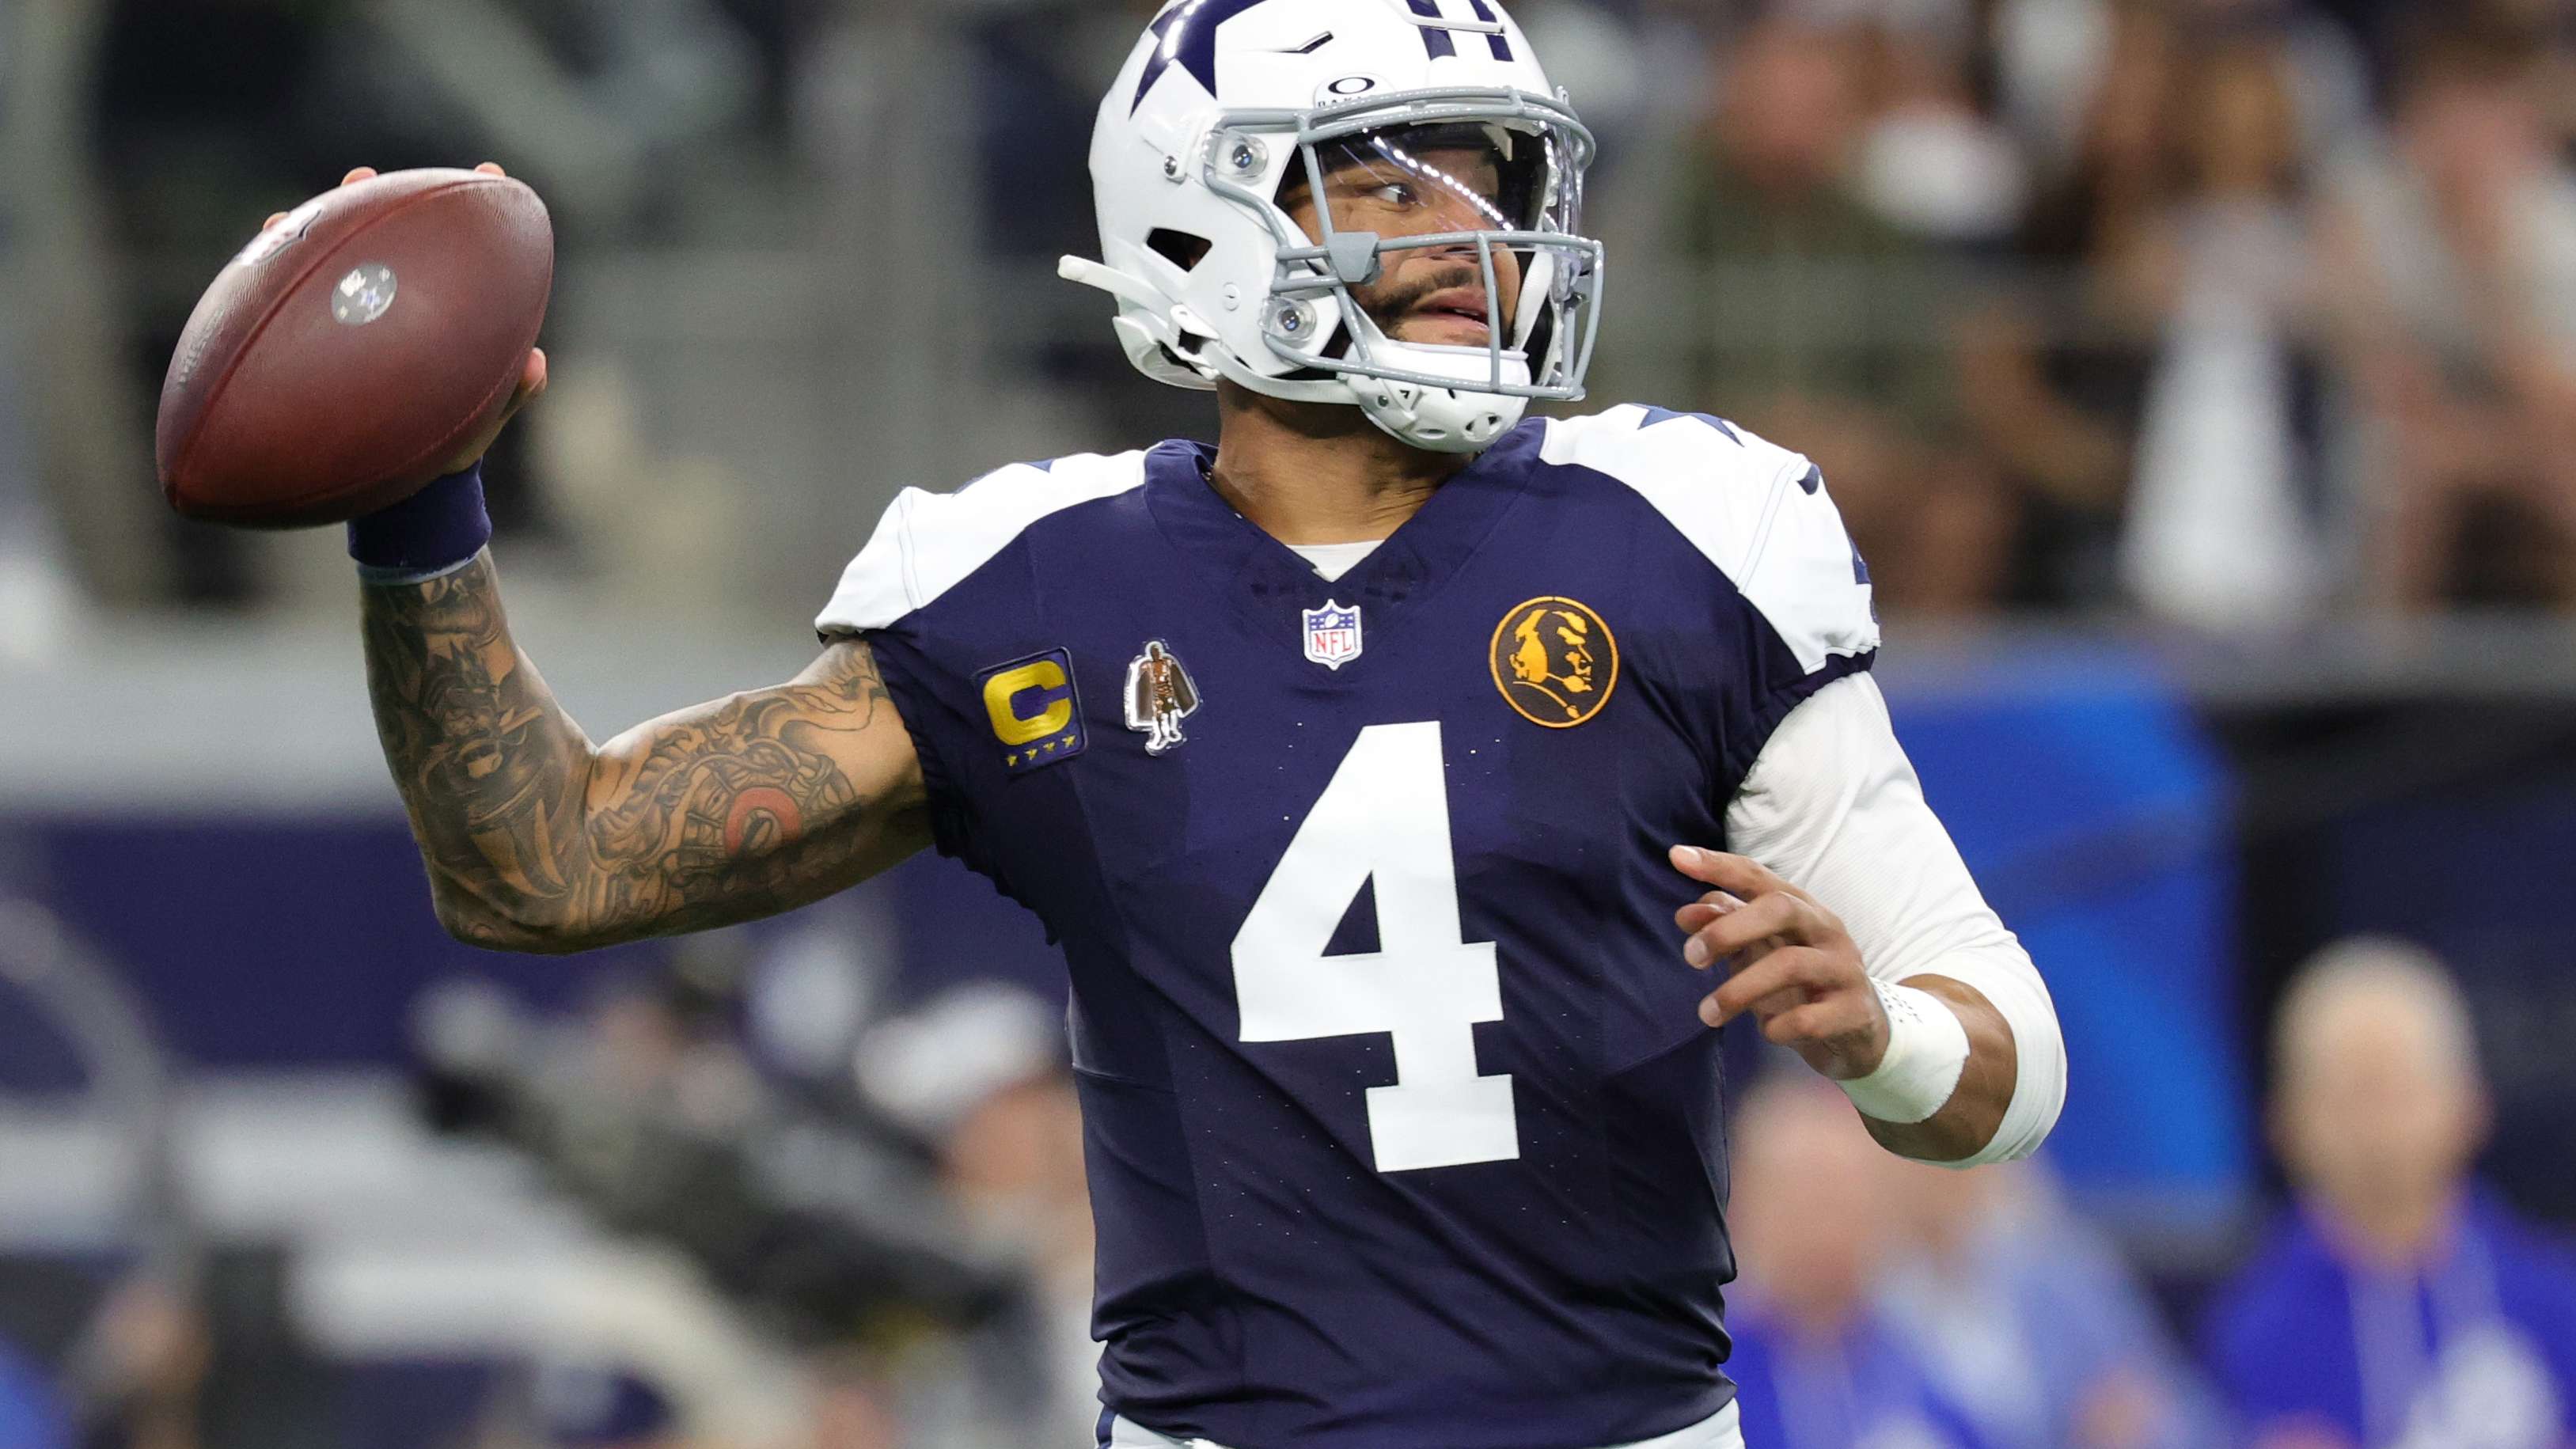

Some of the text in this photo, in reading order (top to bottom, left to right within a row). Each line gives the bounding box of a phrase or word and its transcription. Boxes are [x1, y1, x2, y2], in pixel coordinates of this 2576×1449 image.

[1314, 631, 1352, 655] NFL
[983, 660, 1072, 745] C
[1231, 721, 1519, 1172] 4
